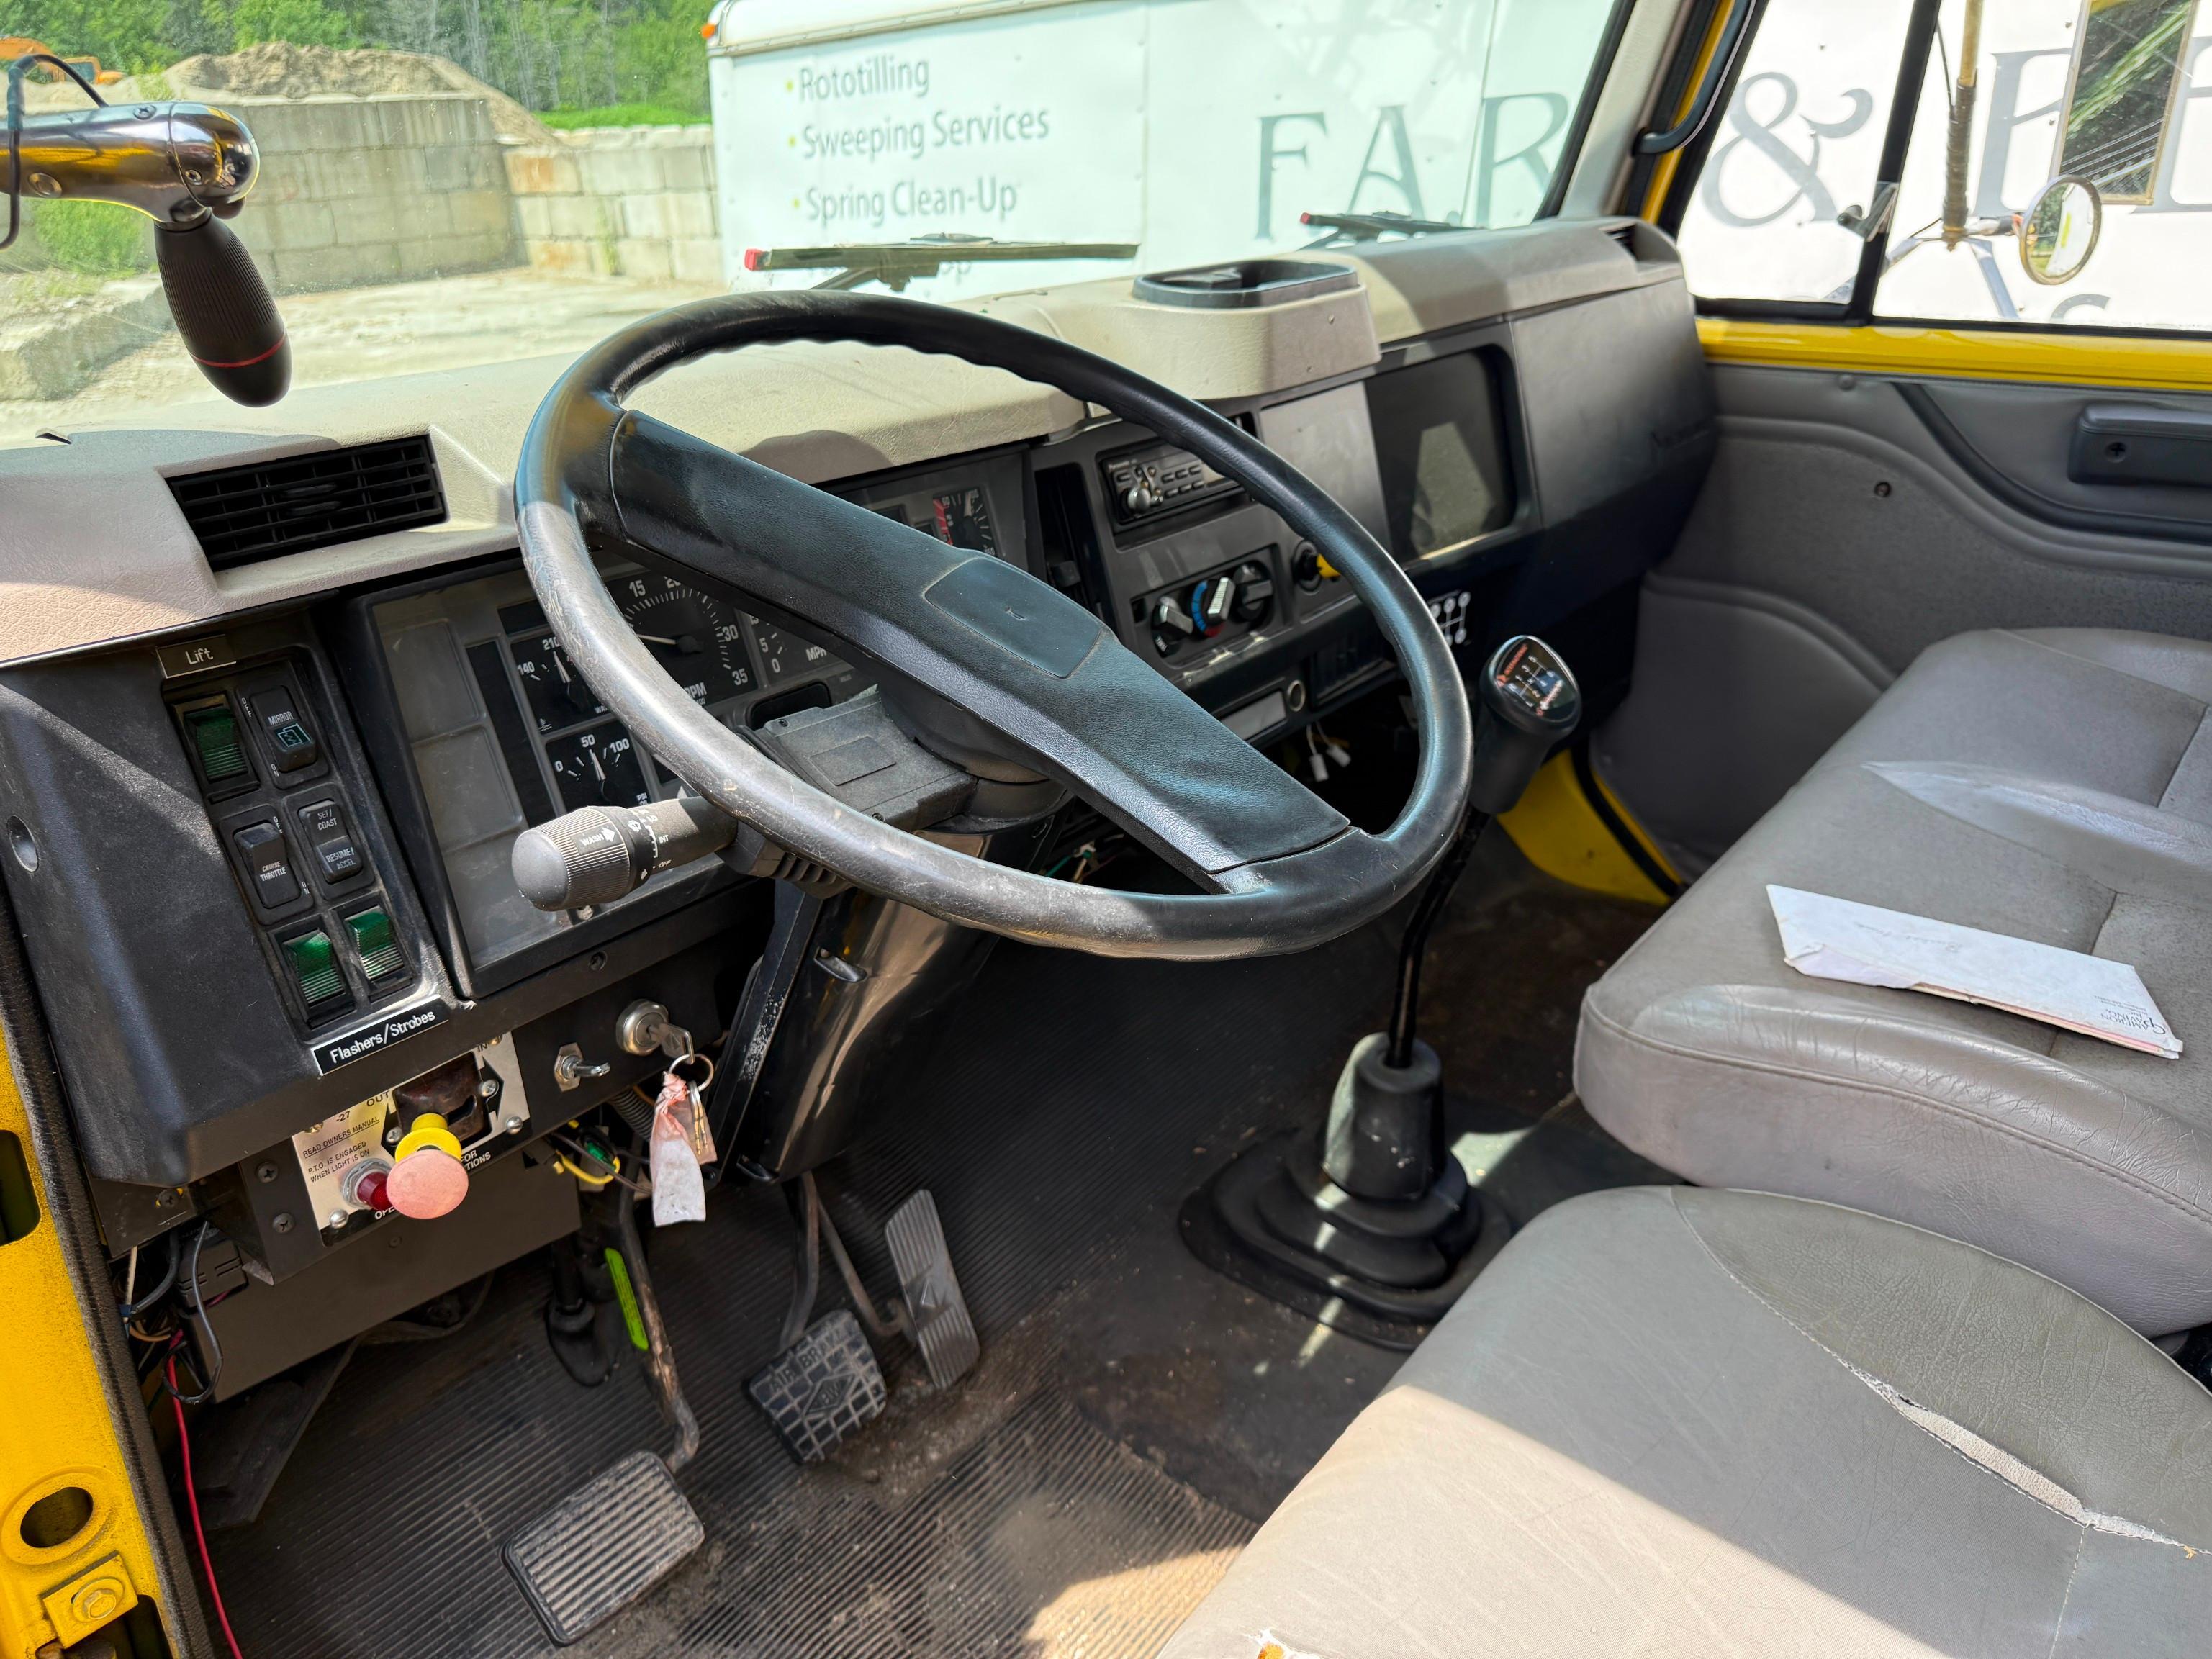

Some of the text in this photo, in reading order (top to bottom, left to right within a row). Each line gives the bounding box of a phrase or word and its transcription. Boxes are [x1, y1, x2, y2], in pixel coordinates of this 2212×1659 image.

[800, 55, 929, 101] Rototilling
[803, 105, 1050, 160] Sweeping Services
[1254, 92, 1570, 243] FAR
[807, 176, 1017, 226] Spring Clean-Up
[629, 579, 646, 597] 15
[721, 624, 739, 642] 30
[759, 637, 769, 653] 5
[185, 648, 214, 665] Lift
[805, 646, 827, 661] MPH
[518, 661, 535, 675] 140
[772, 658, 781, 673] 0
[732, 668, 749, 686] 35
[268, 711, 294, 725] MIRROR
[580, 734, 595, 748] 50
[610, 738, 629, 753] 100
[554, 760, 564, 772] 0
[317, 818, 338, 831] COAST
[580, 834, 605, 846] WASH
[659, 835, 669, 844] INT
[262, 861, 281, 872] CRUISE
[337, 859, 356, 870] ACCEL
[260, 867, 286, 882] THROTTLE
[330, 1011, 435, 1064] Flashers/Strobes
[477, 1042, 488, 1053] IN
[366, 1090, 390, 1107] OUT
[303, 1116, 380, 1157] READ OWNERS MANUAL
[308, 1162, 325, 1175] P.T.O.
[335, 1142, 366, 1160] ENGAGED
[311, 1169, 330, 1183] WHEN
[332, 1159, 351, 1172] LIGHT
[360, 1149, 370, 1158] ON
[464, 1152, 491, 1171] TIONS
